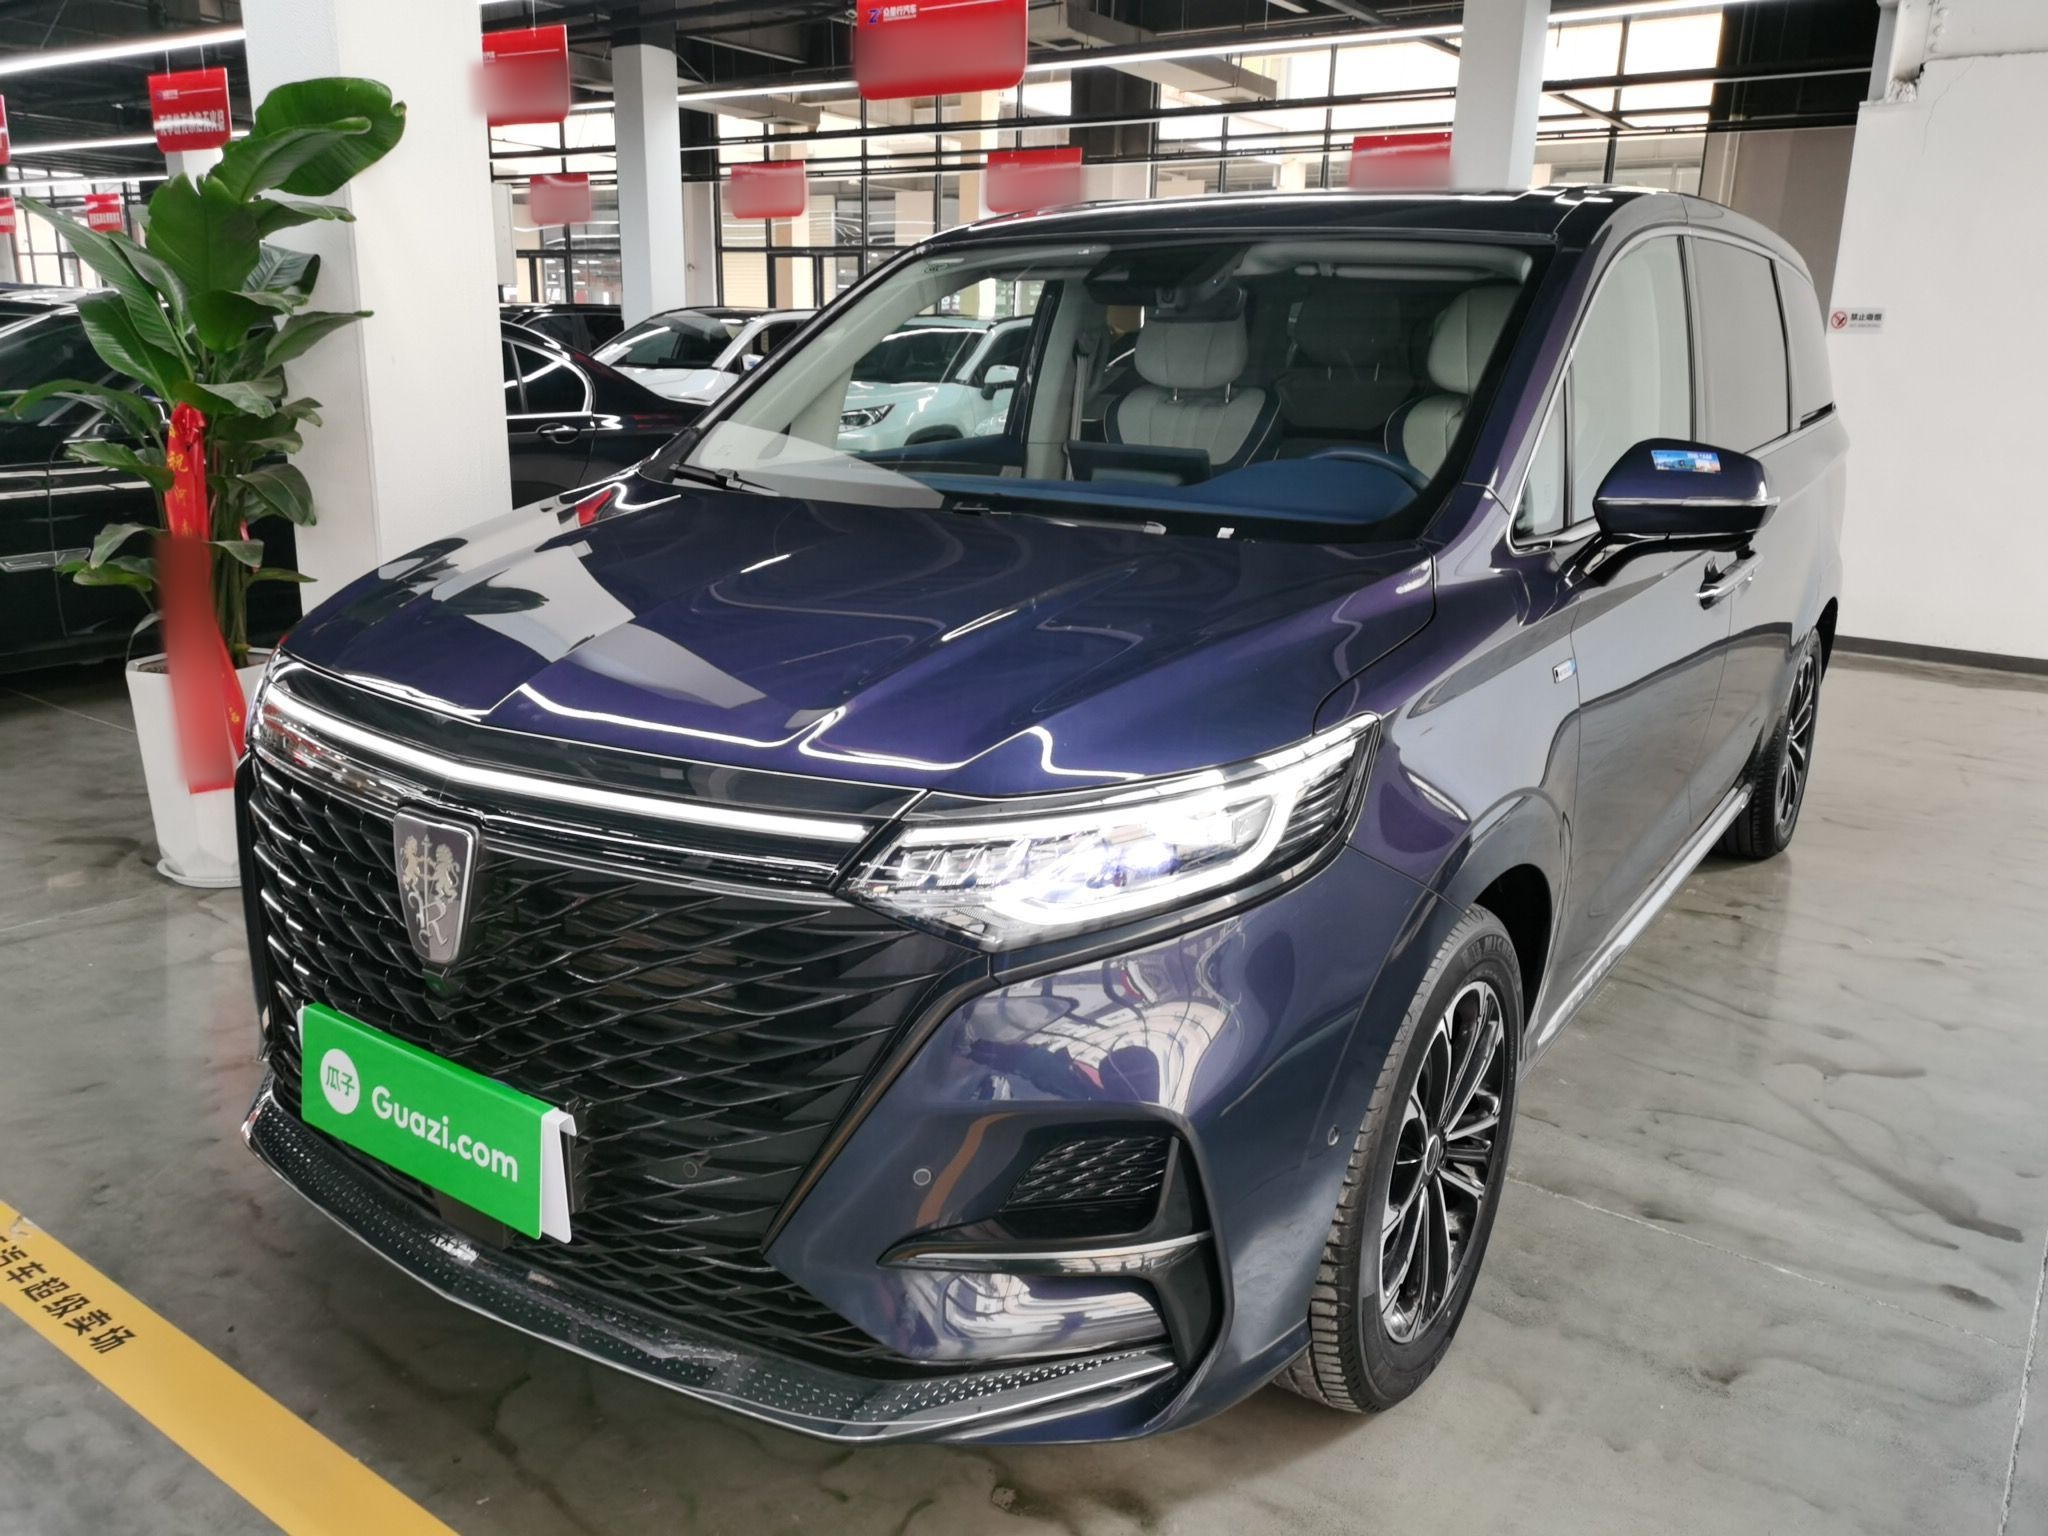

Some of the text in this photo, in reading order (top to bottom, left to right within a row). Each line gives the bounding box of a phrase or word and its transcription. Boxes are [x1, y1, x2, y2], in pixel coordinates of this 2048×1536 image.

[326, 1065, 519, 1184] 瓜子 Guazi.com
[0, 1235, 137, 1355] 汽车超级卖场
